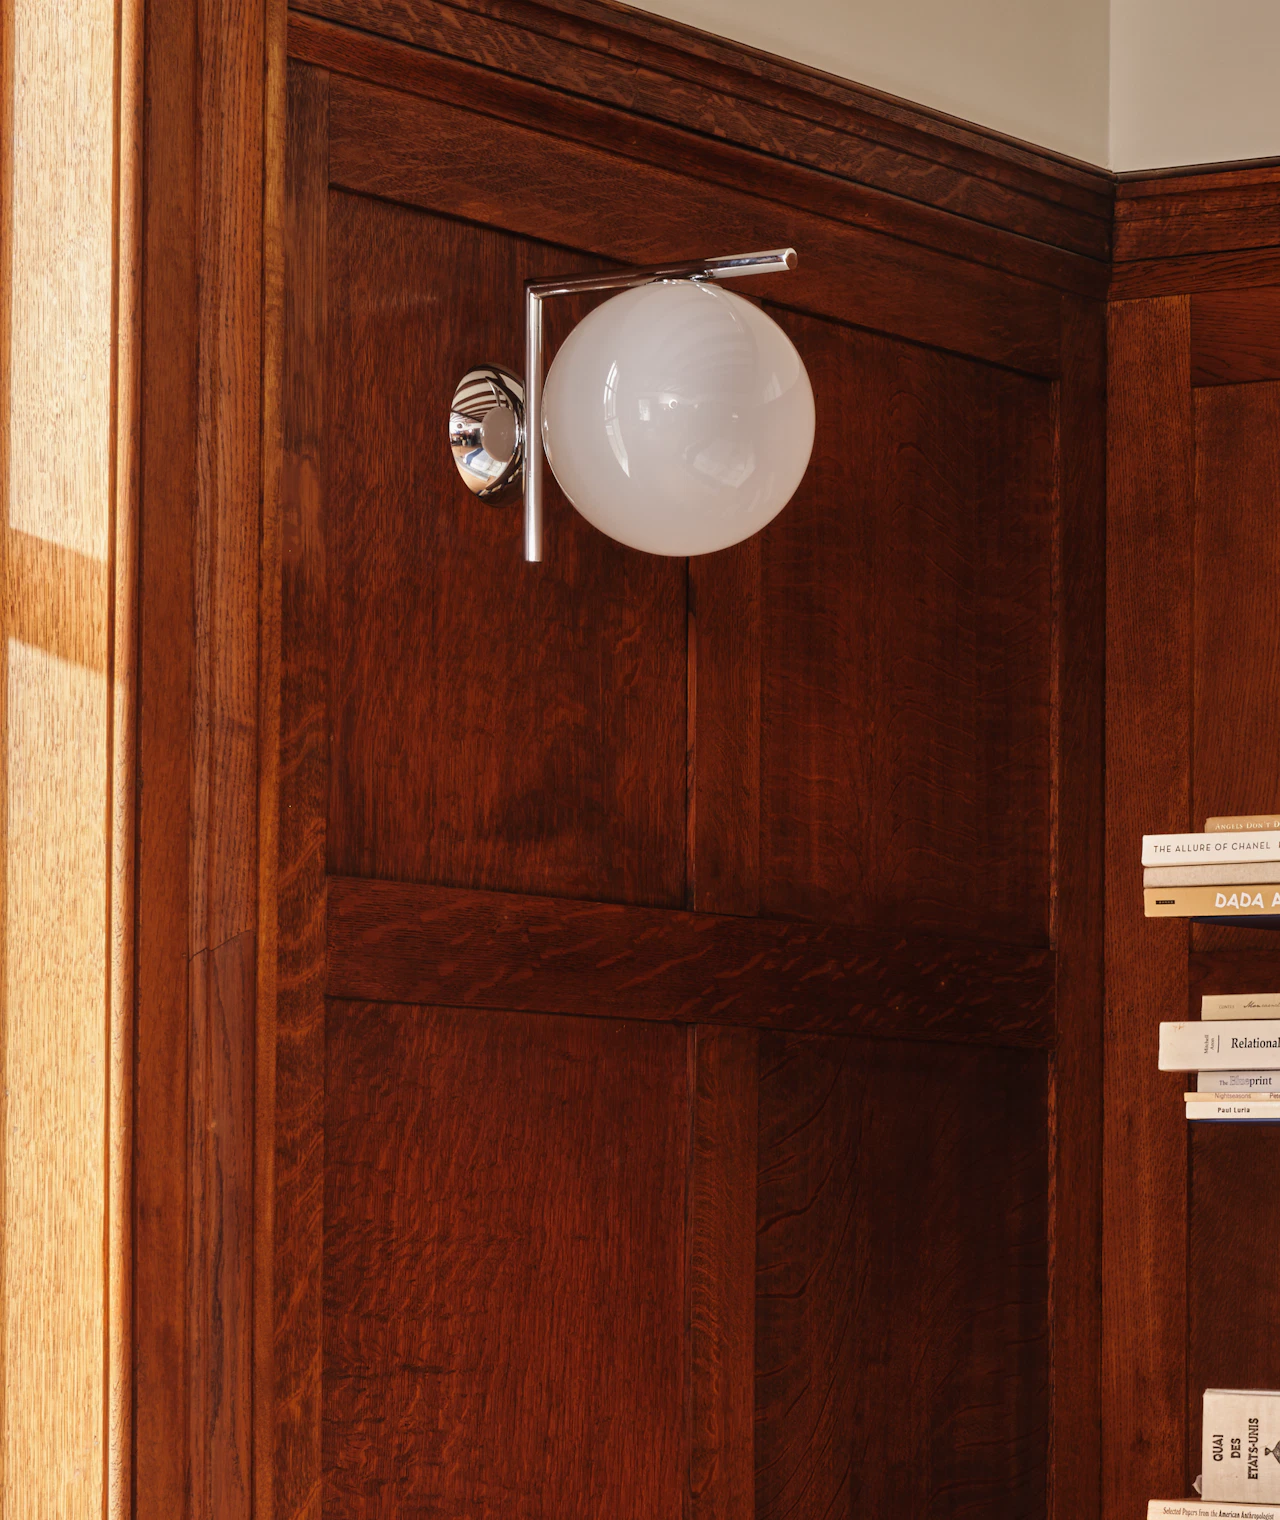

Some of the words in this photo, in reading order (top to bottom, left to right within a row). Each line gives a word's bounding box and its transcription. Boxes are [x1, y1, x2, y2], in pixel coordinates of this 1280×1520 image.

[1215, 823, 1243, 831] ANGELS
[1153, 844, 1172, 853] THE
[1175, 843, 1211, 852] ALLURE
[1214, 842, 1228, 851] OF
[1231, 841, 1271, 850] CHANEL
[1214, 892, 1265, 909] DADA
[1231, 1037, 1280, 1050] Relational
[1214, 1092, 1251, 1100] Nightseasons
[1212, 1434, 1224, 1462] QUAI
[1230, 1438, 1241, 1459] DES
[1247, 1417, 1259, 1480] ETATS-UNIS
[1163, 1507, 1182, 1515] Selected
[1182, 1508, 1198, 1517] Papers
[1198, 1508, 1210, 1517] from
[1210, 1509, 1218, 1517] the
[1218, 1510, 1240, 1518] American
[1240, 1511, 1275, 1520] Anthropologist
